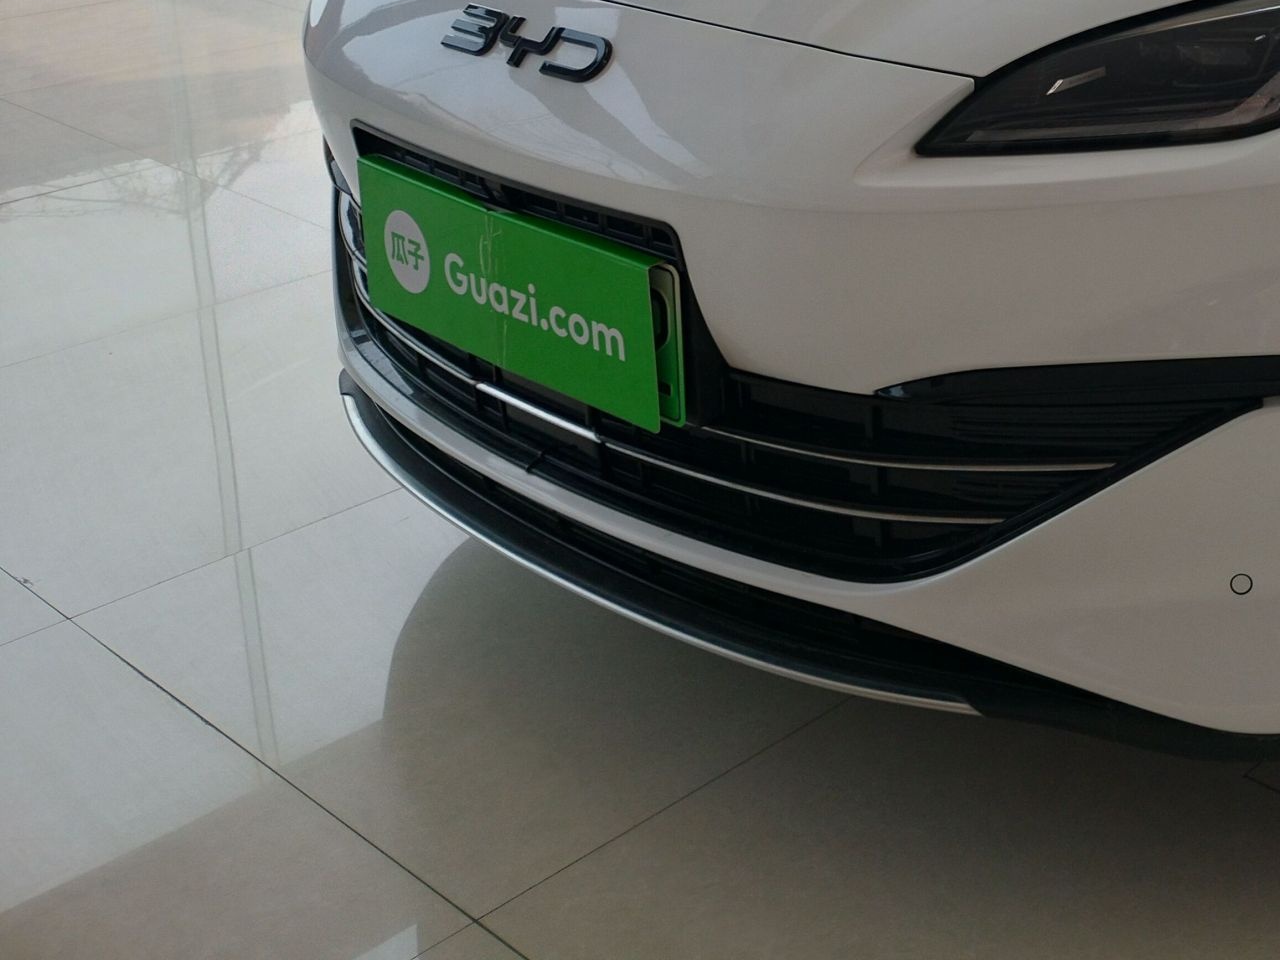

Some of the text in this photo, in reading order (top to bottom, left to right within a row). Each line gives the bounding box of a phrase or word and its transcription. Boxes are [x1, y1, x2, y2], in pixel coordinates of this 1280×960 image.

[441, 3, 614, 83] BYD
[390, 232, 425, 272] 瓜子
[444, 253, 628, 363] Guazi.com
